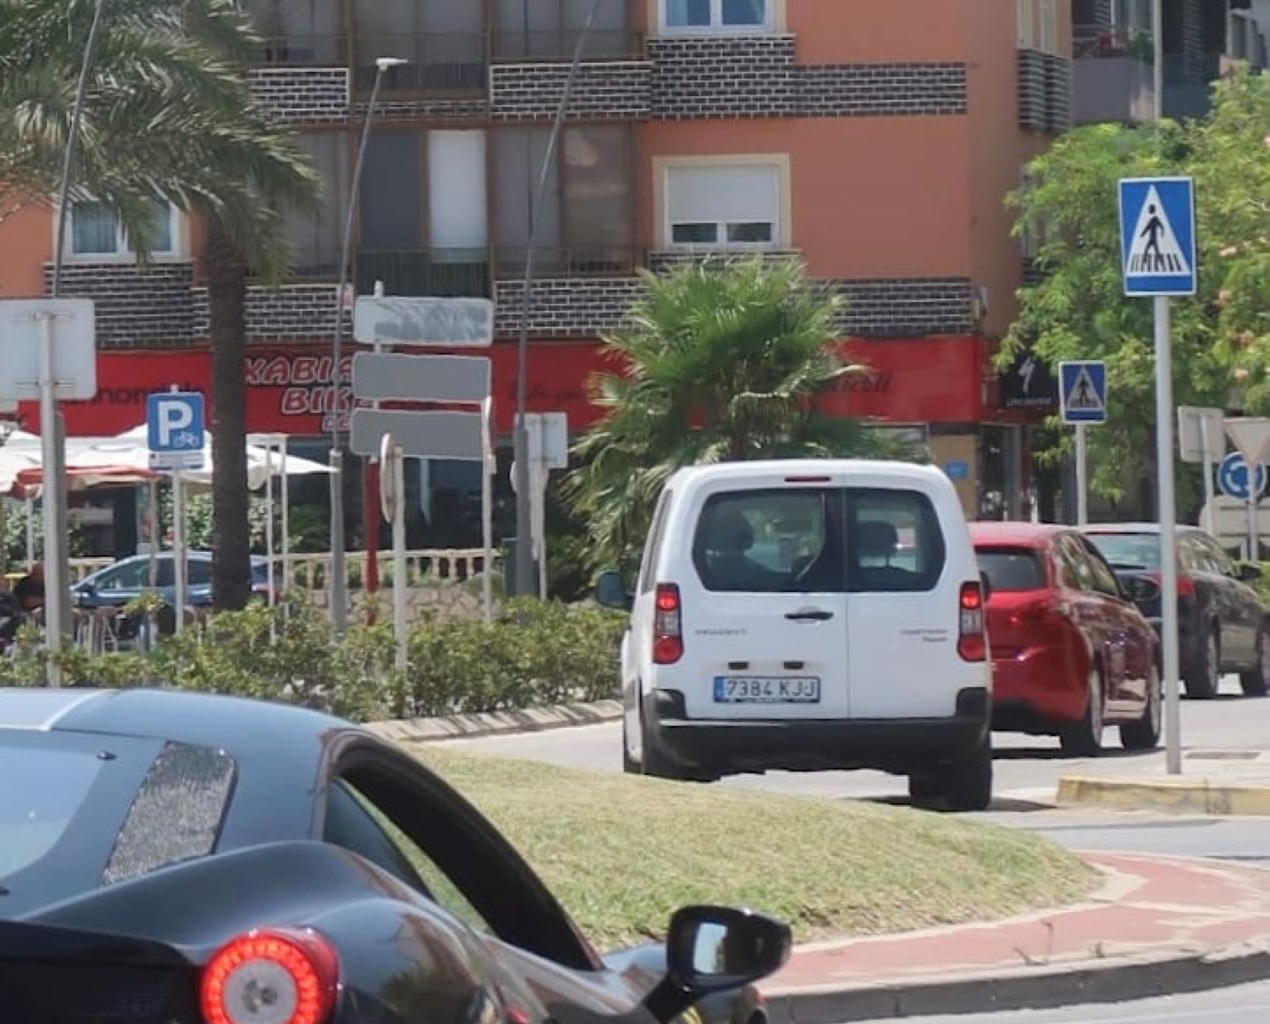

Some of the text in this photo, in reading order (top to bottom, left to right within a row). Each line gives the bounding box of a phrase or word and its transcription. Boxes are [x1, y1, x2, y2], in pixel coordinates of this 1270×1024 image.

[157, 401, 193, 446] P
[726, 681, 815, 697] 7384 KJJ
